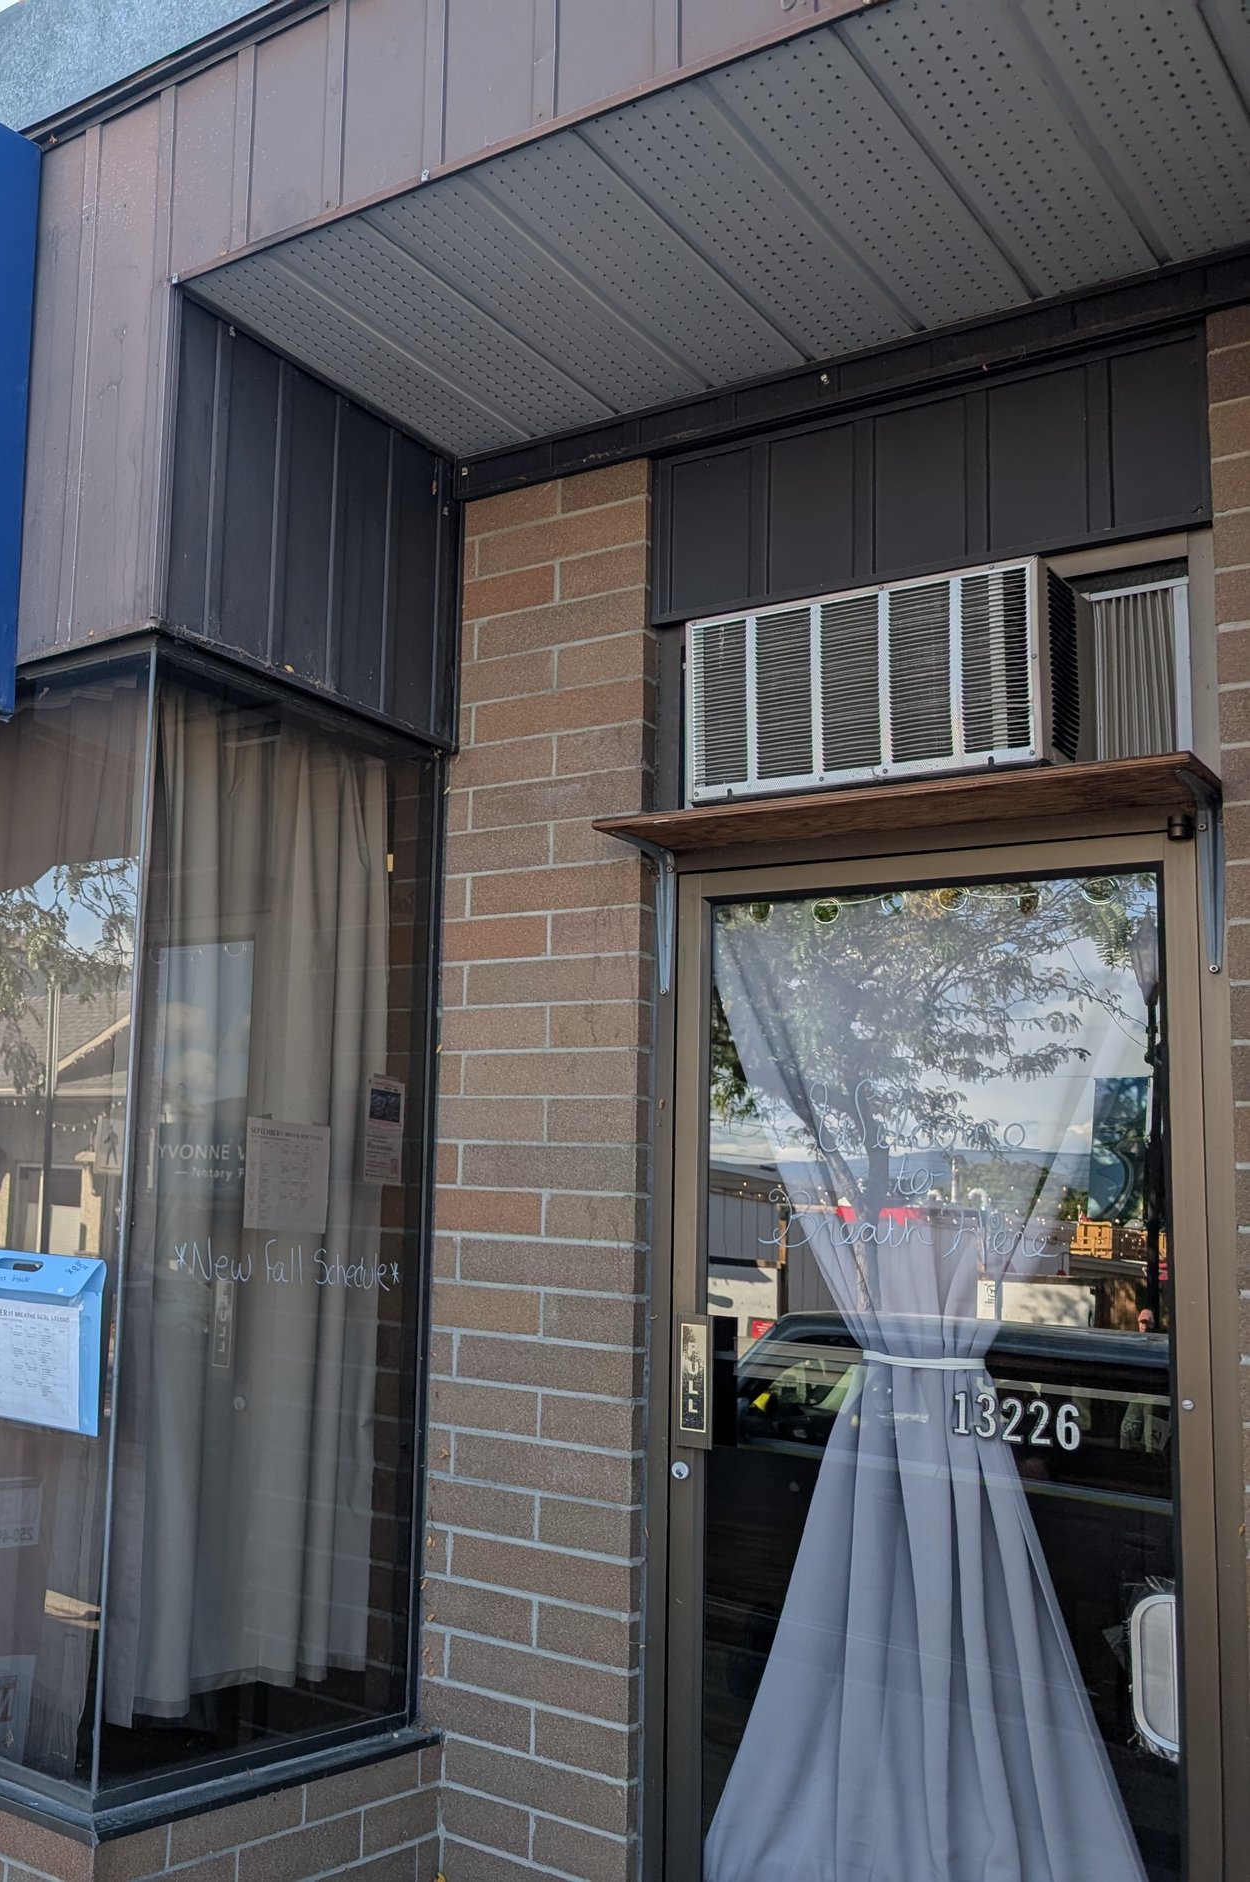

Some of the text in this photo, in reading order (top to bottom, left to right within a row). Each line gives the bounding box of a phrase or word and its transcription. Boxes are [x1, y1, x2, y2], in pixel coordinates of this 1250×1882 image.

[158, 1144, 230, 1161] YVONNE
[192, 1167, 233, 1181] Notary
[893, 1153, 945, 1196] to
[265, 1239, 302, 1285] Fall
[952, 1391, 1081, 1451] 13226
